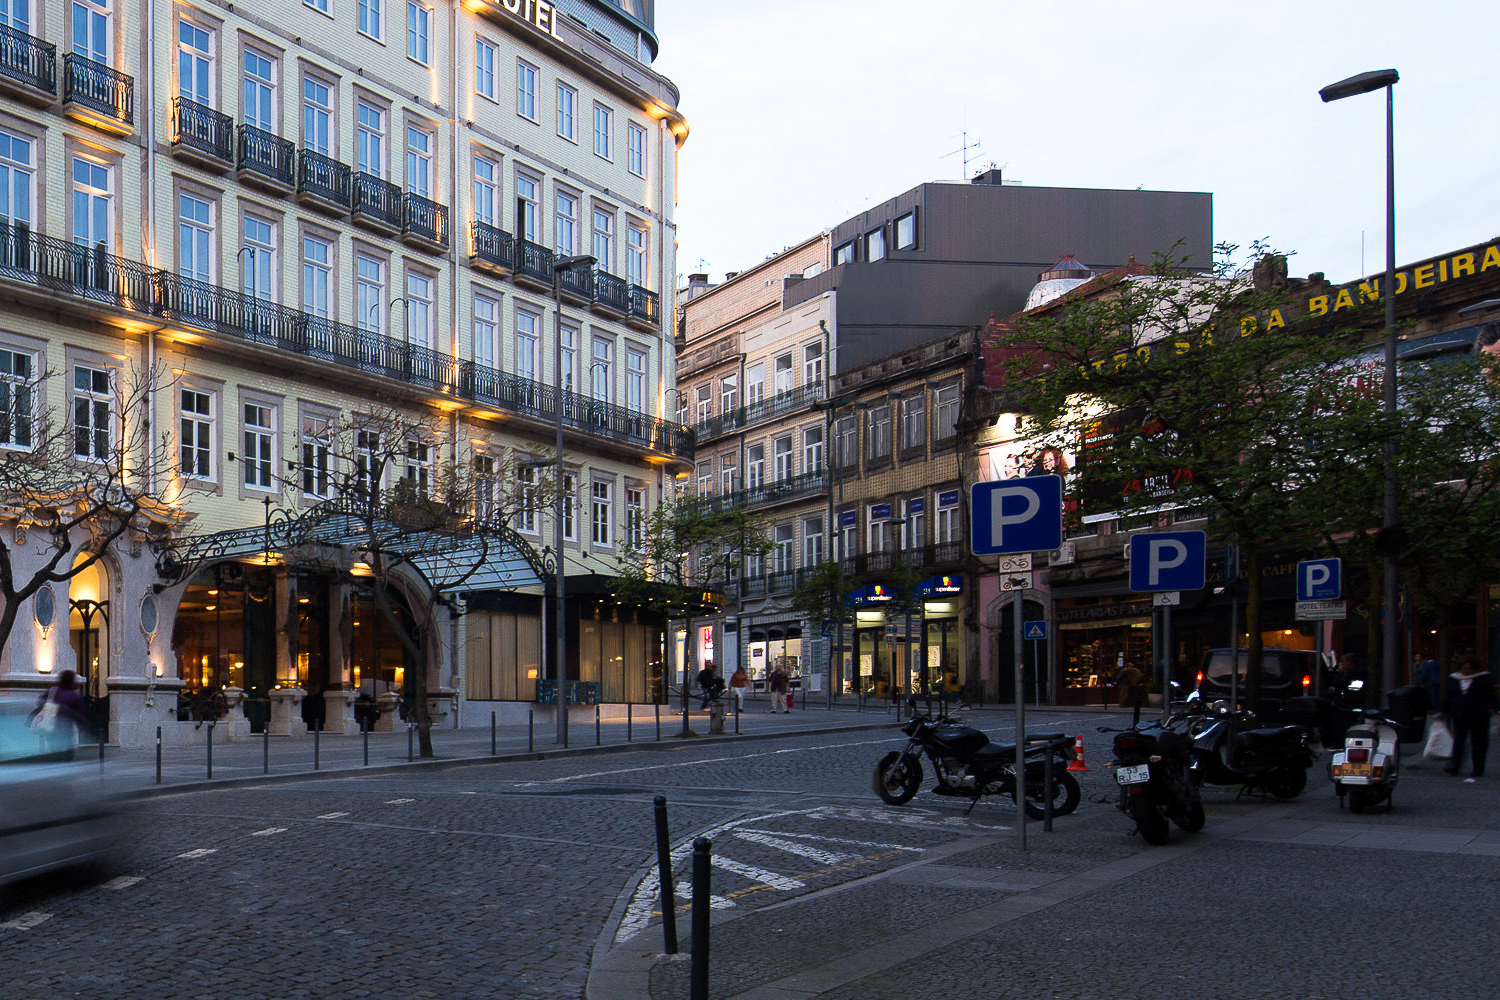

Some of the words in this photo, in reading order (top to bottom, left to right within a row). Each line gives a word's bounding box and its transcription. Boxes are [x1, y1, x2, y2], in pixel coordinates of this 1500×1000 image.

[1241, 309, 1286, 338] DA
[1309, 246, 1500, 317] BANDEIRA
[991, 487, 1040, 547] P
[1149, 539, 1187, 585] P
[1262, 564, 1297, 577] CAFF
[1306, 564, 1331, 597] P
[1126, 767, 1138, 775] 53
